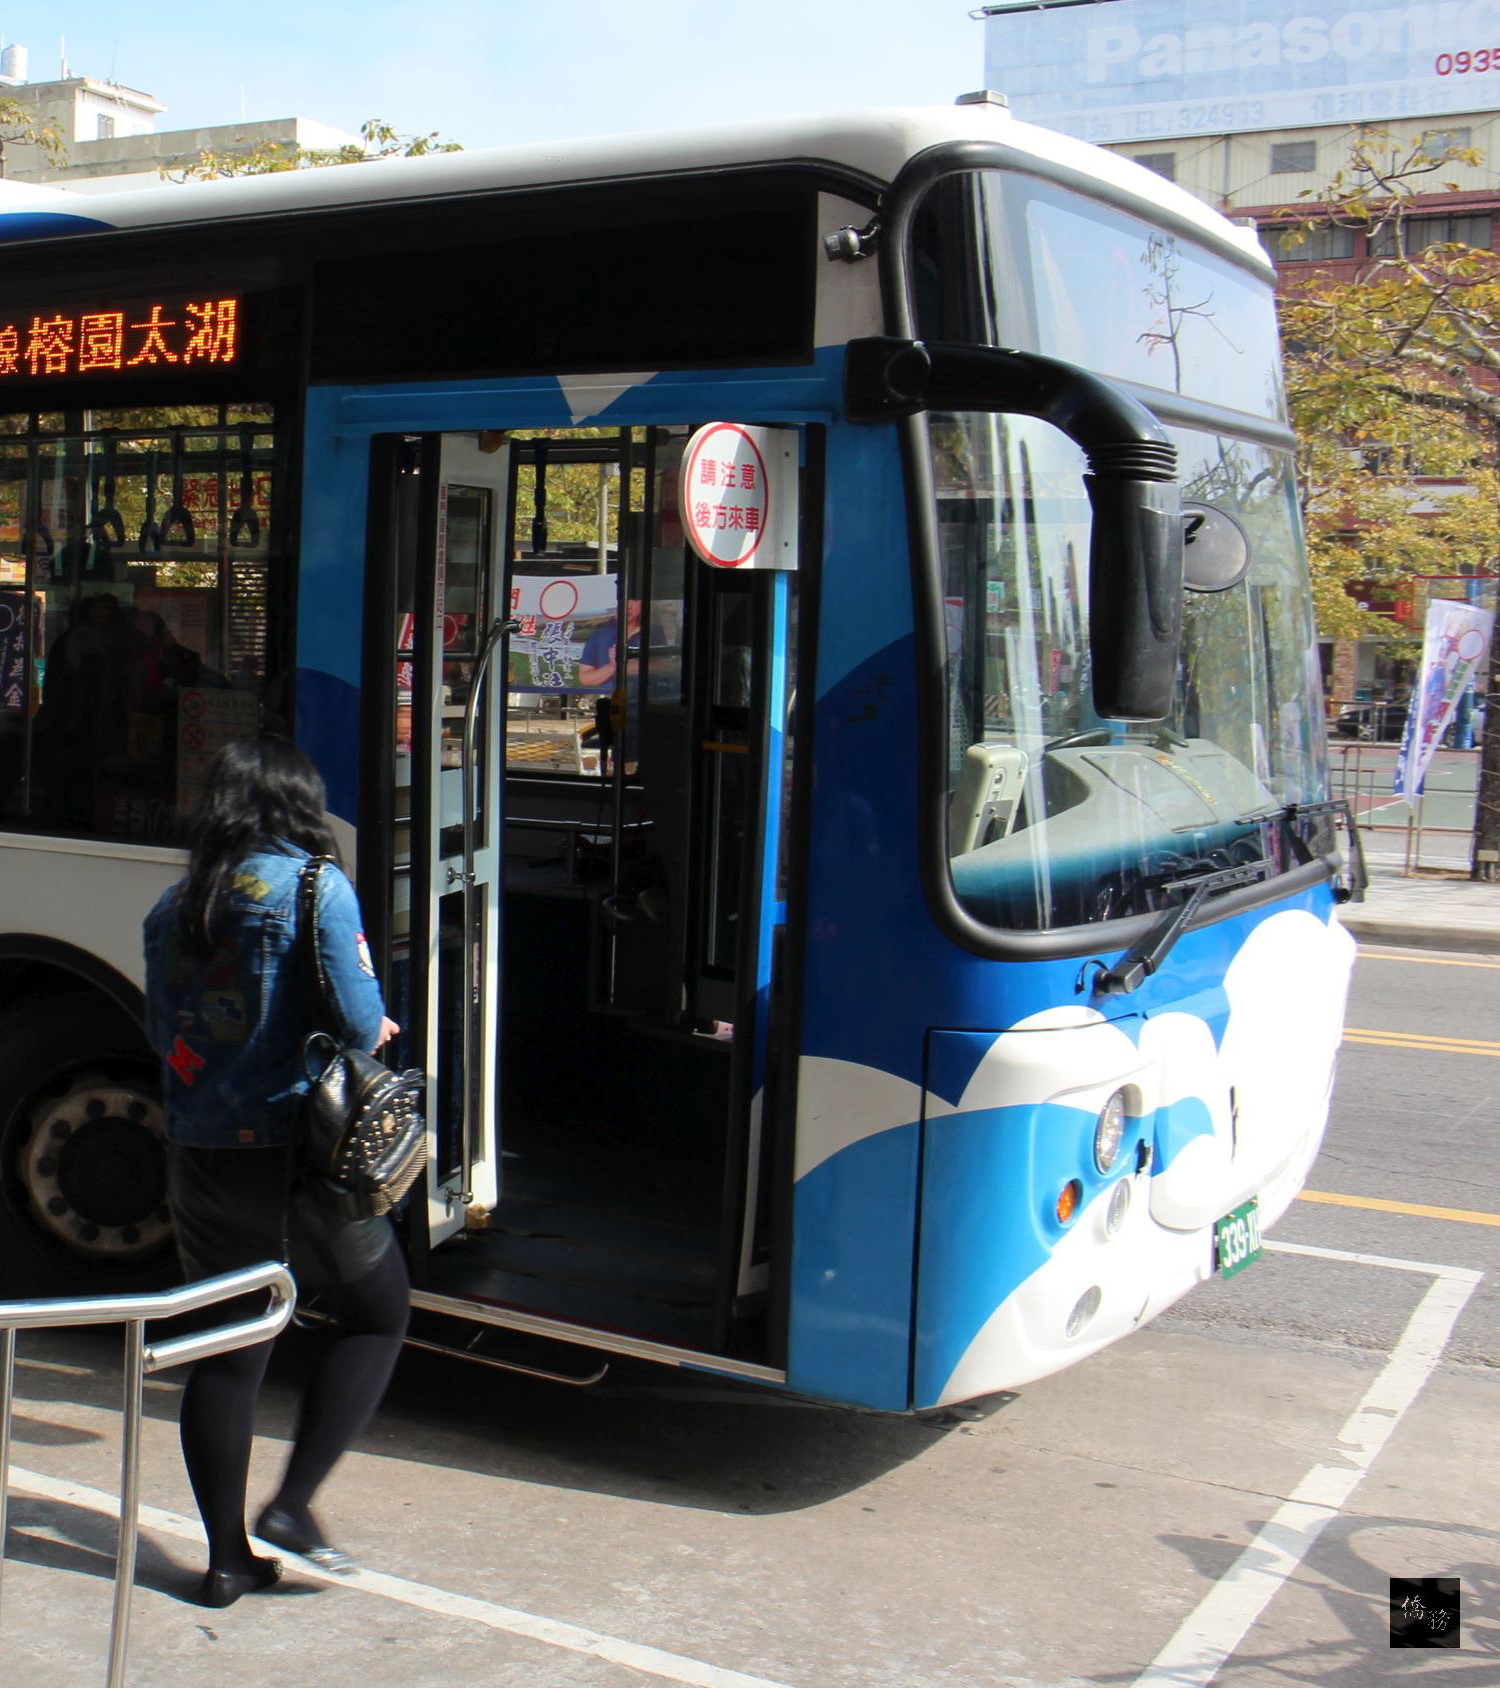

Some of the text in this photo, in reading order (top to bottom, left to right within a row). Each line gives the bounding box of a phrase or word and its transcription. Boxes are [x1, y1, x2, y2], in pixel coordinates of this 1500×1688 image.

[1086, 0, 1500, 84] Panasonic
[700, 458, 756, 490] 請注意
[695, 501, 760, 533] 後方來車
